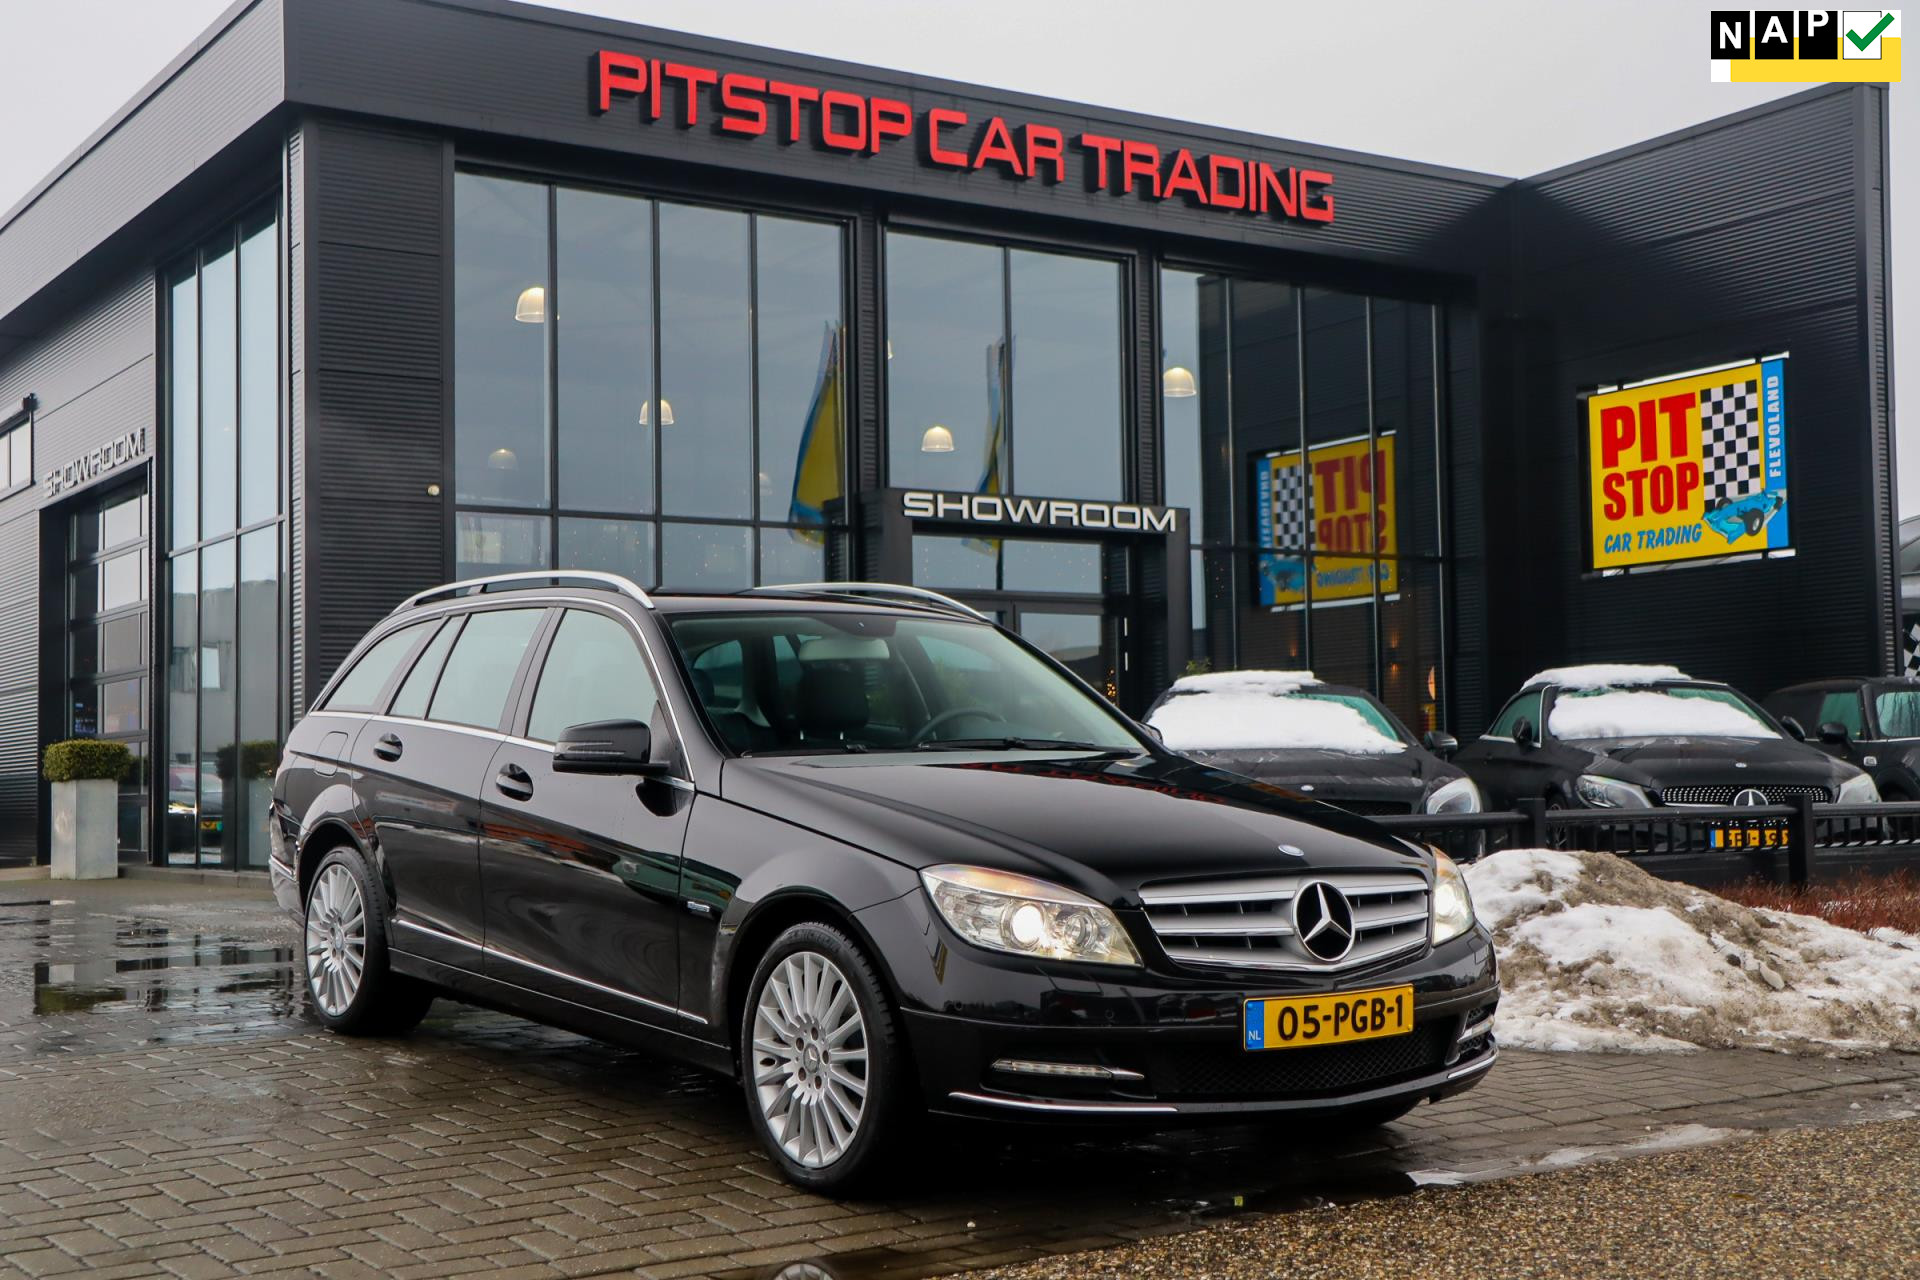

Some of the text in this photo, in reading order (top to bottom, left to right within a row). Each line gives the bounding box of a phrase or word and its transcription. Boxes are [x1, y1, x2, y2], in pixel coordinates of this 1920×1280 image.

[599, 49, 1335, 223] PITSTOP CAR TRADING
[1600, 392, 1697, 470] PIT
[1766, 375, 1783, 478] FLEVOLAND
[43, 427, 145, 498] SHOWROOM
[1603, 461, 1700, 521] STOP
[903, 492, 1176, 533] SHOWROOM
[1604, 523, 1702, 554] CAR TRADING
[1248, 994, 1403, 1042] NL 05-PGB-1
